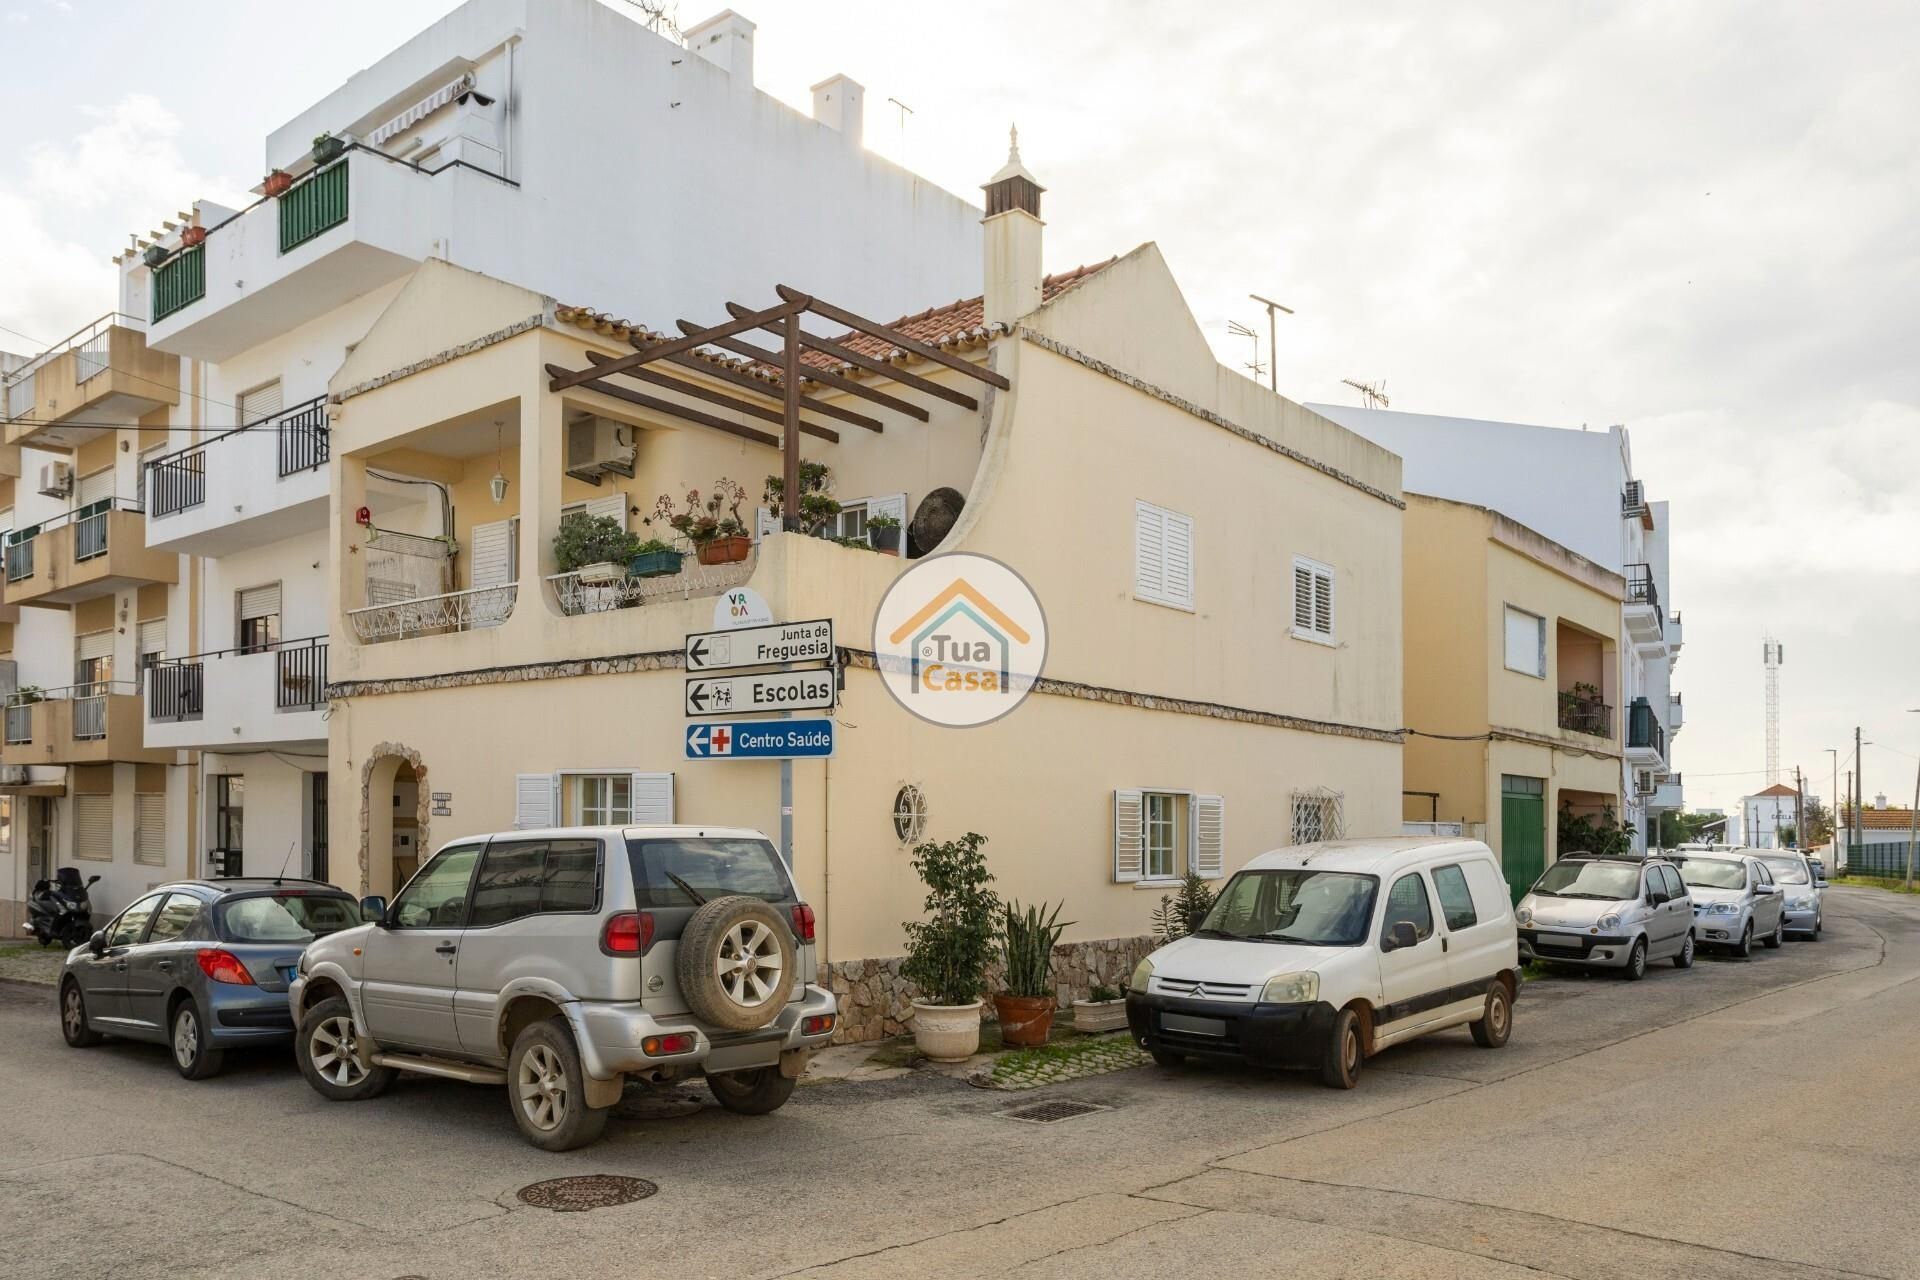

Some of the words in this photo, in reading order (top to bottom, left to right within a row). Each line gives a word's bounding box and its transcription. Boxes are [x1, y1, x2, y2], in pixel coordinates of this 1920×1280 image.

[781, 628, 811, 641] Junta
[814, 625, 828, 638] de
[757, 640, 829, 660] Freguesia
[753, 679, 829, 704] Escolas
[740, 732, 784, 748] Centro
[787, 731, 831, 747] Saúde
